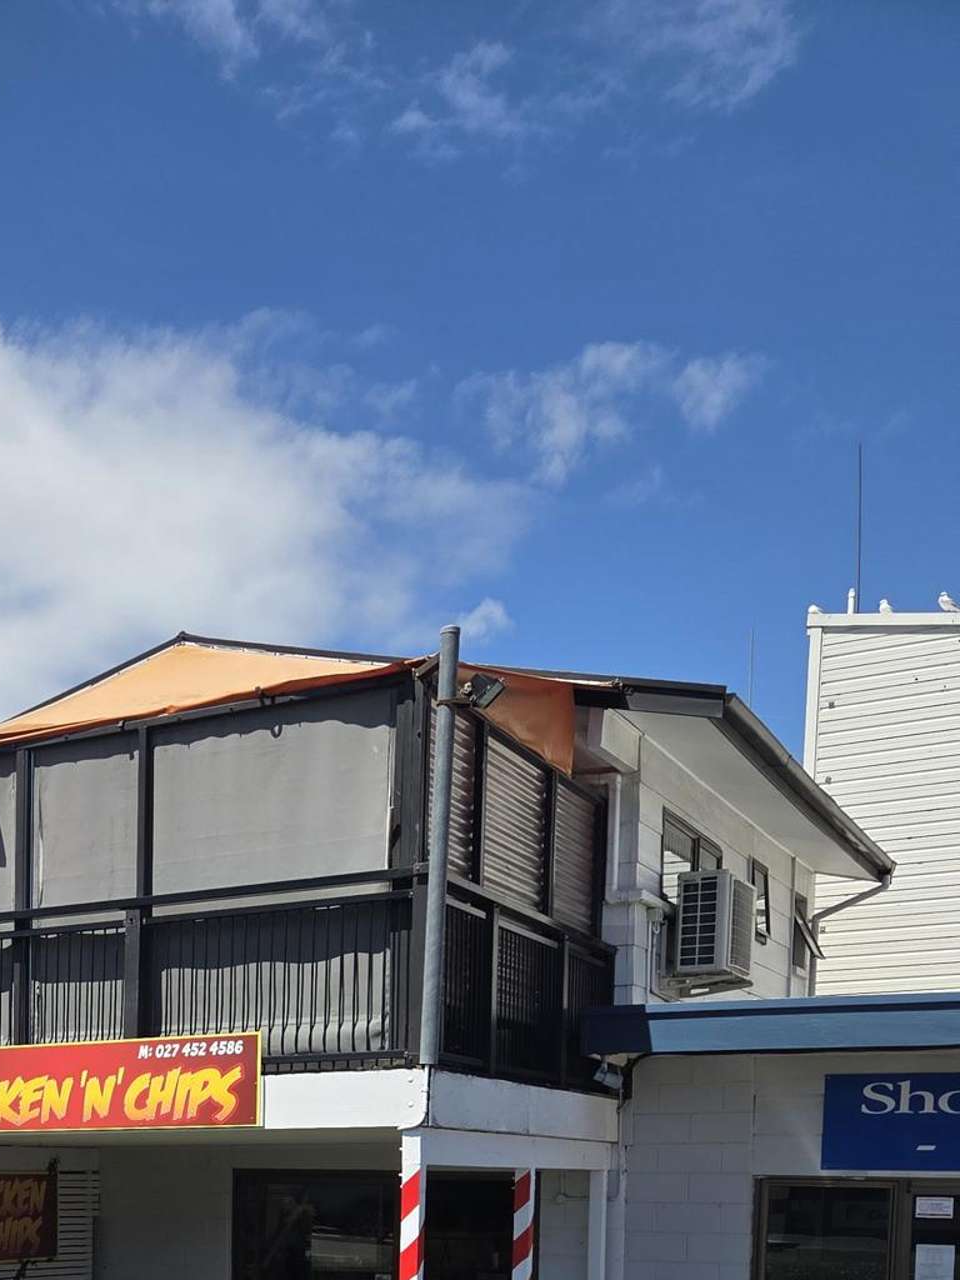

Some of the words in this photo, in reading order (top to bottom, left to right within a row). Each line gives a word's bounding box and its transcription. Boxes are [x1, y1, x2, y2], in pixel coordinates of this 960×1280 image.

[156, 1043, 179, 1058] 027
[181, 1042, 206, 1057] 452
[209, 1040, 244, 1056] 4586
[125, 1063, 245, 1122] CHIPS
